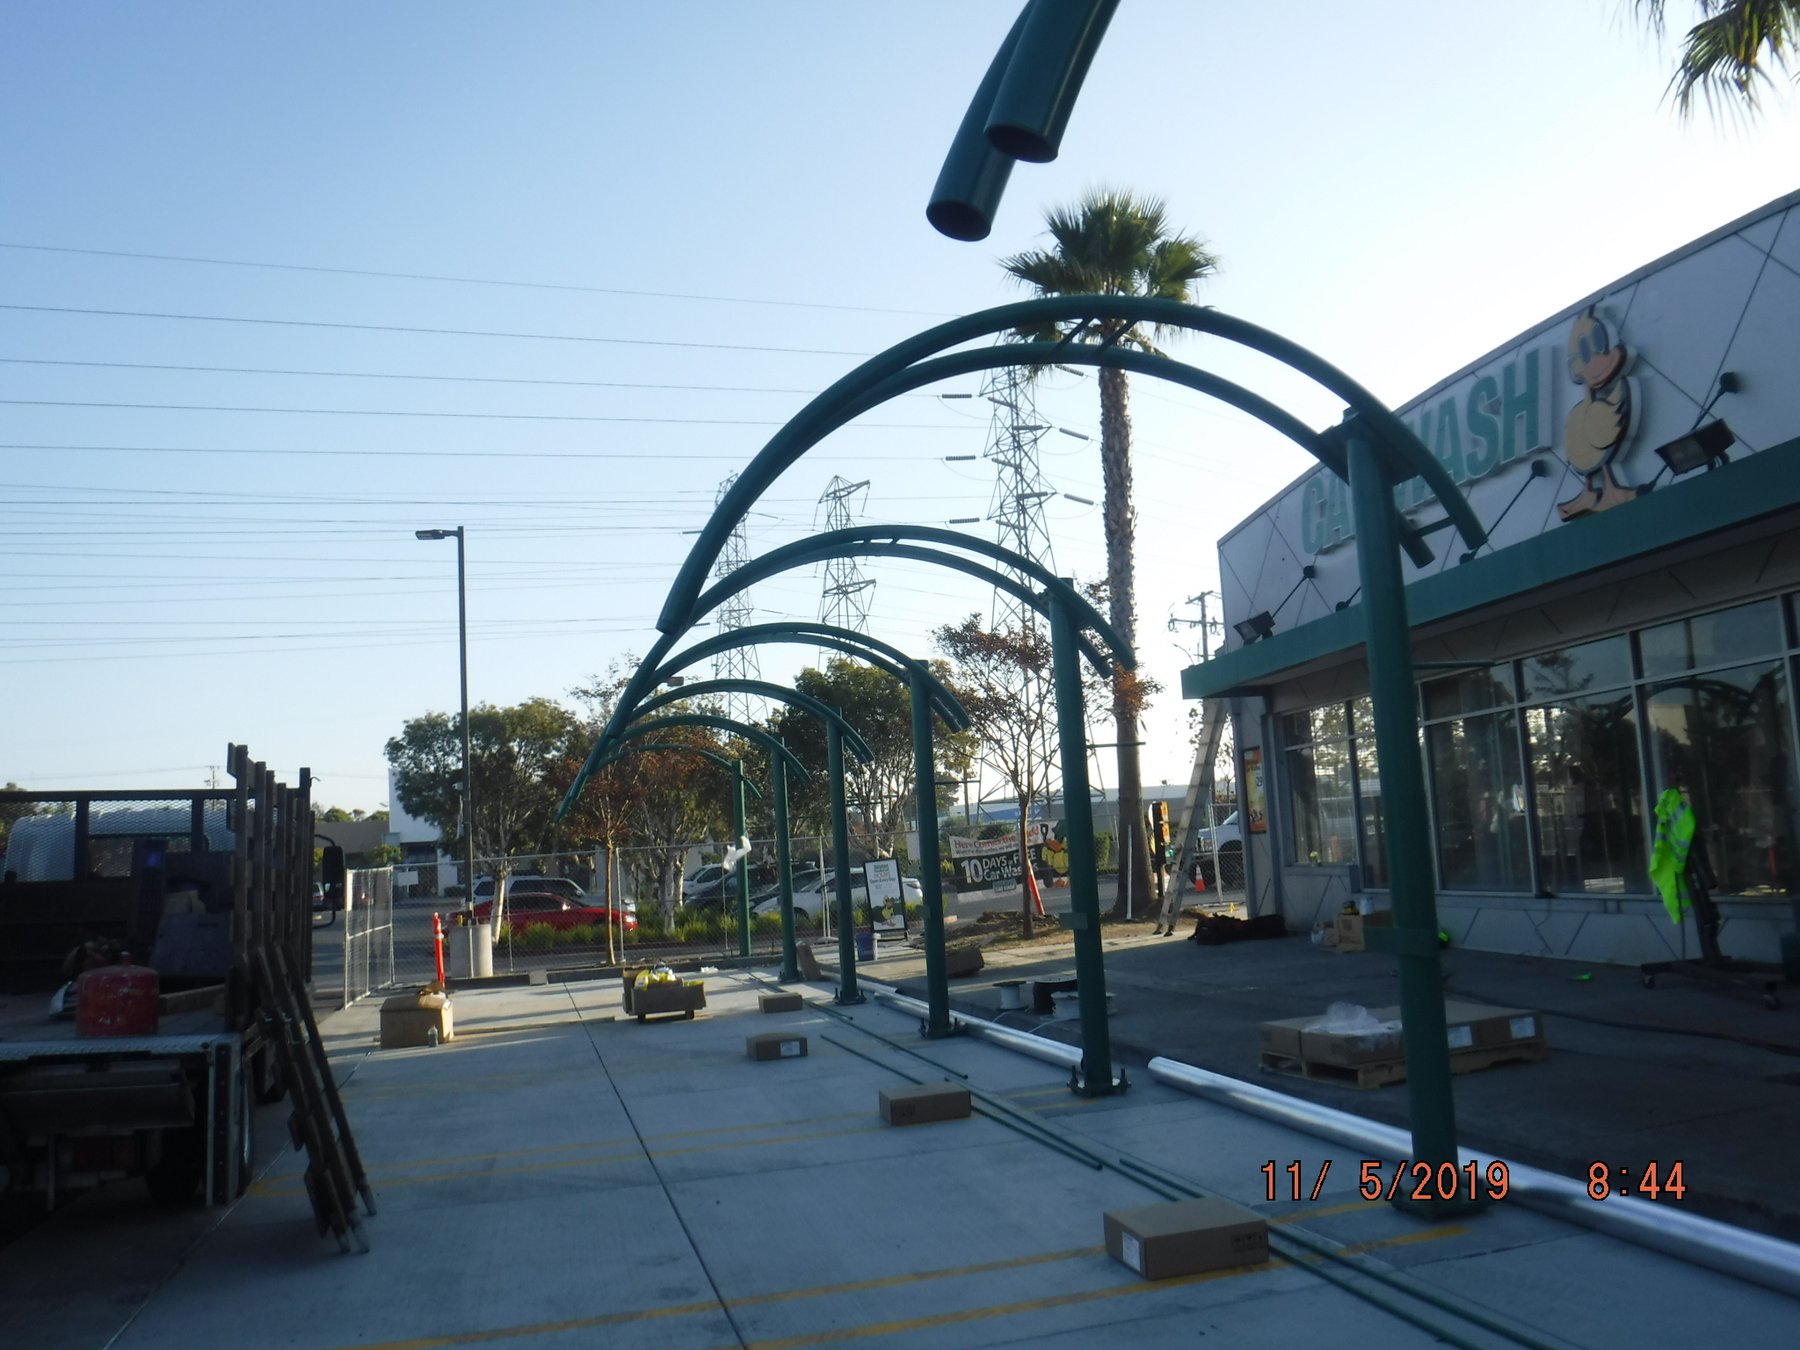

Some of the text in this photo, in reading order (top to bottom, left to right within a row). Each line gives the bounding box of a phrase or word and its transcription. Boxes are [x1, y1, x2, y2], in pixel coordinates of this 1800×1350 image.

[1302, 474, 1355, 555] CA
[961, 858, 983, 884] 10
[983, 856, 1006, 869] DAYS
[984, 867, 1000, 880] Car
